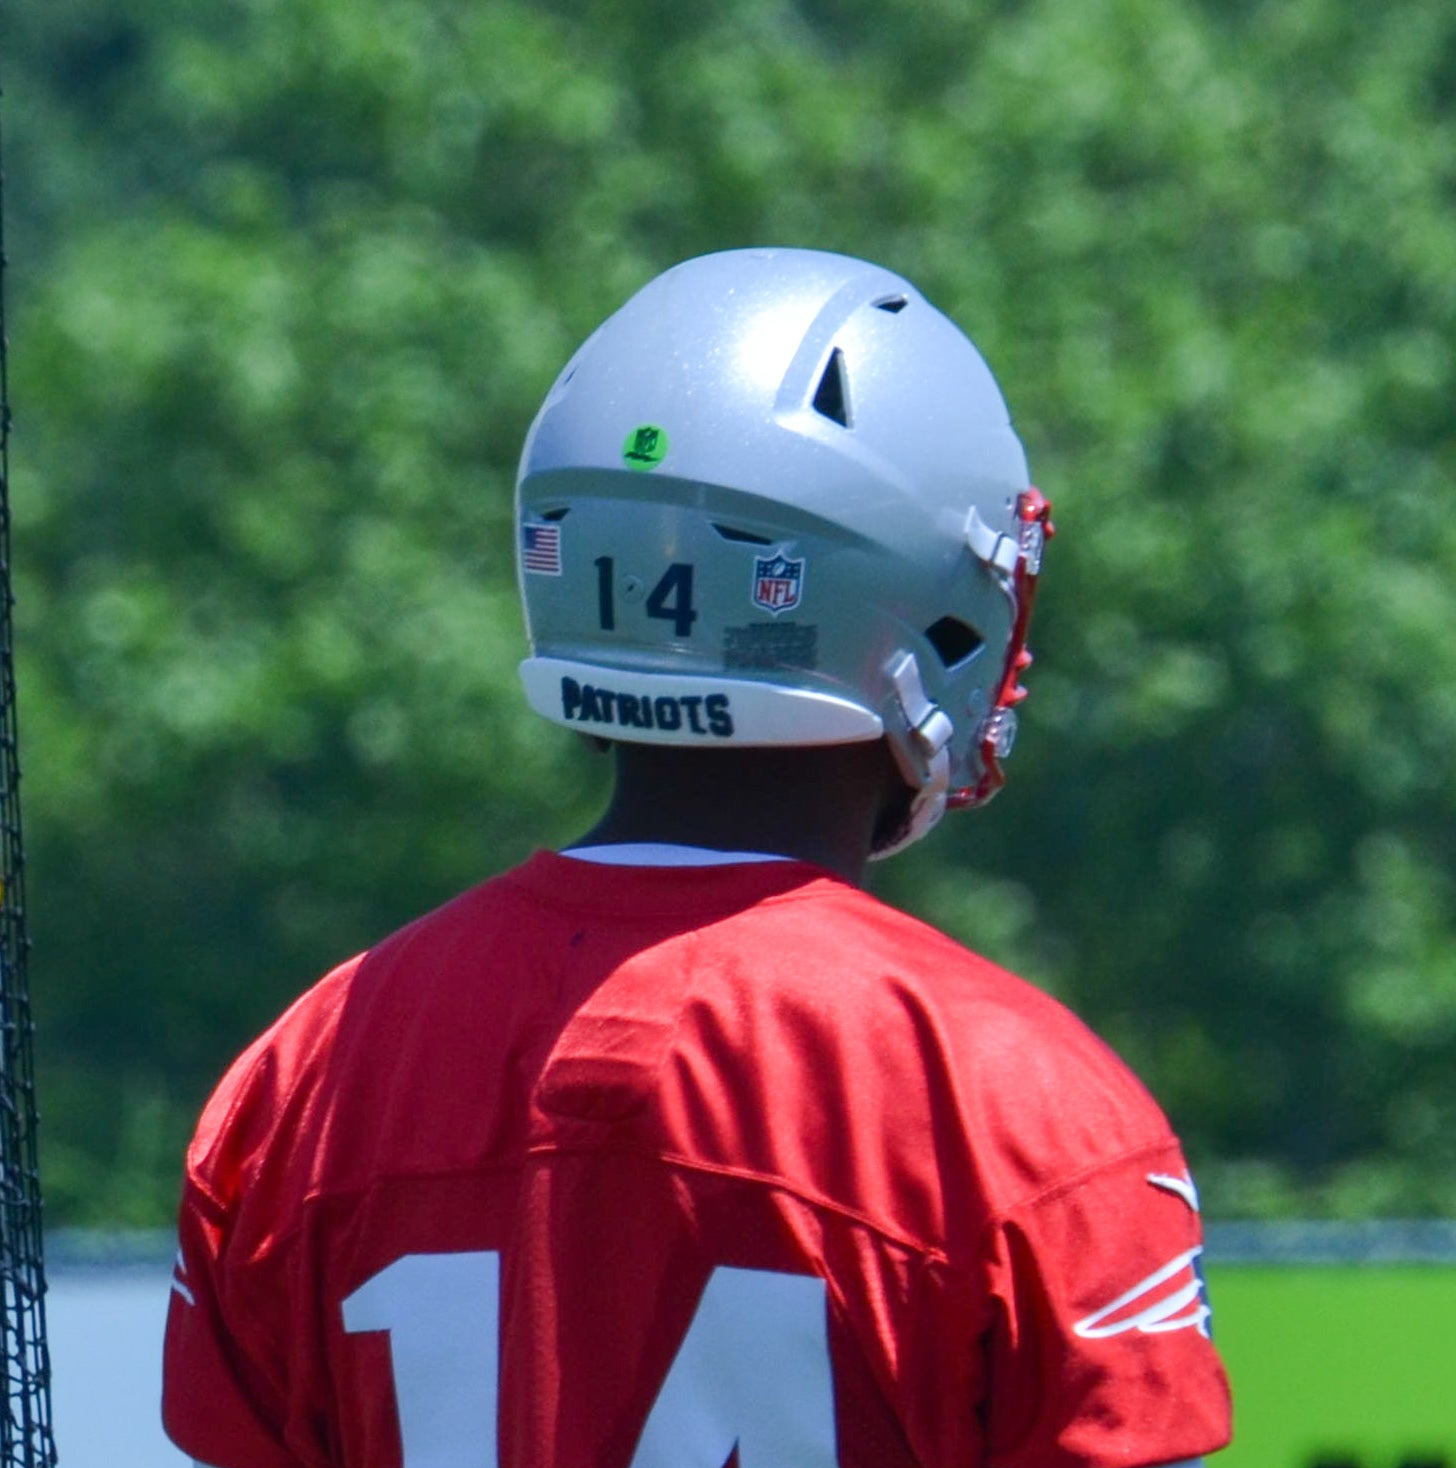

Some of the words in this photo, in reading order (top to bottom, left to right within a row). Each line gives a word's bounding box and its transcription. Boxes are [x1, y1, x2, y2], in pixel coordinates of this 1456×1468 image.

[594, 556, 697, 637] 14
[756, 577, 797, 606] NFL
[561, 676, 735, 738] PATRIOTS
